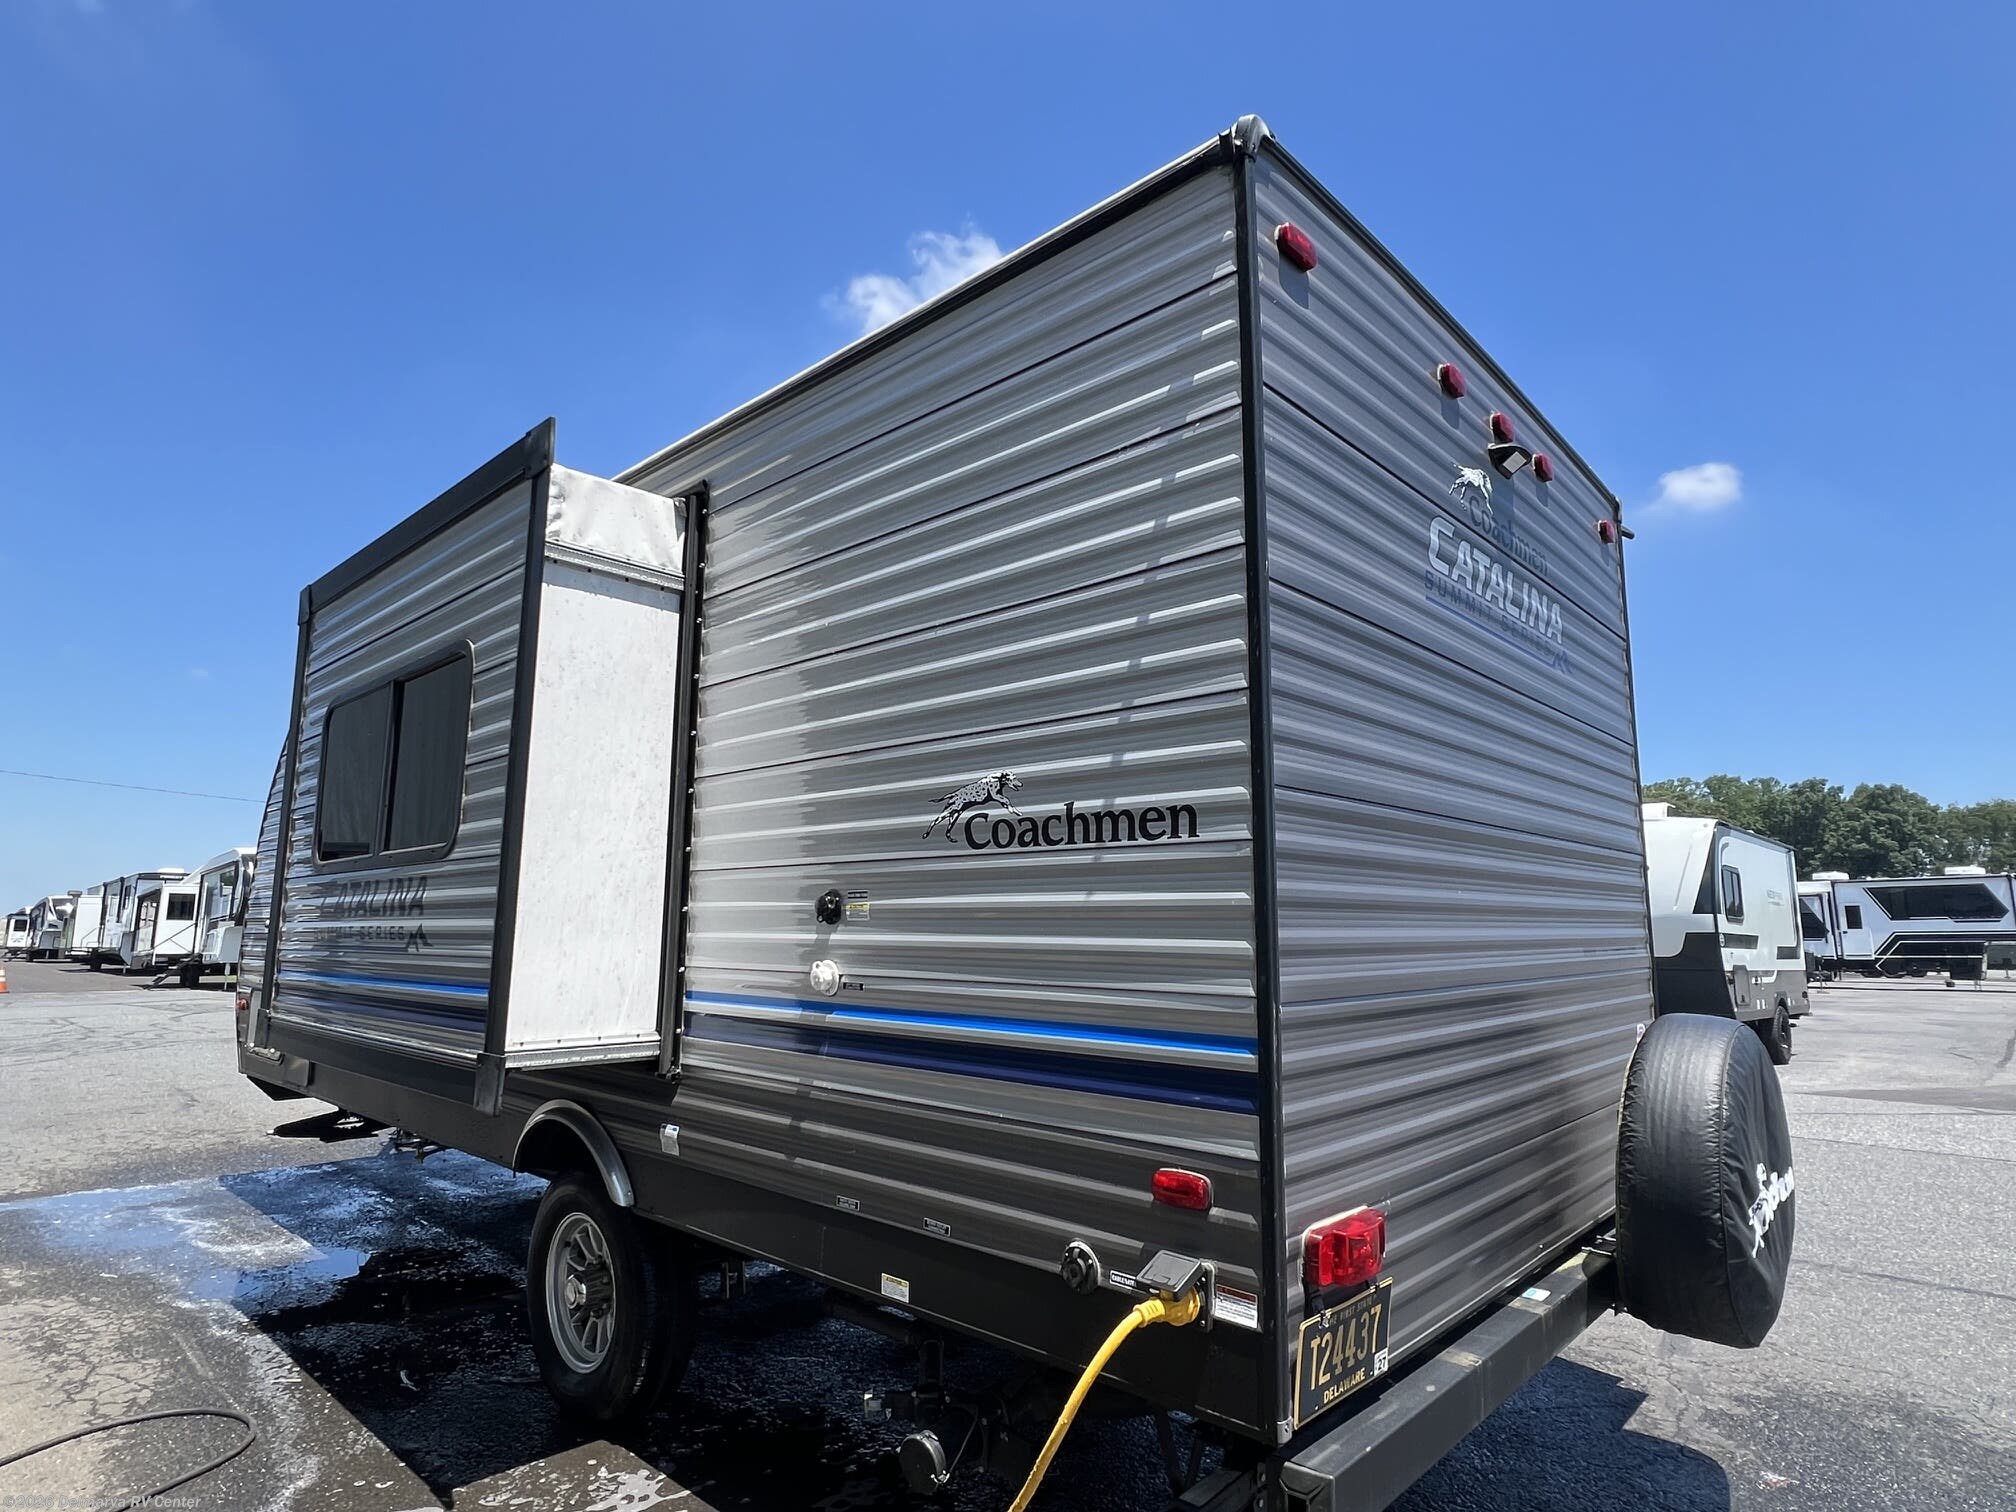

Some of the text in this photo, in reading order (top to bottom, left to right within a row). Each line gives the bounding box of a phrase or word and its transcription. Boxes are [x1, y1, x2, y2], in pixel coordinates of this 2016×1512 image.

[1468, 495, 1549, 576] Coachmen
[1427, 515, 1563, 645] CATALINA
[963, 801, 1200, 850] Coachmen
[359, 925, 406, 940] SERIES
[1310, 1303, 1382, 1390] T24437
[1377, 1355, 1387, 1371] 27
[1323, 1367, 1366, 1404] DELAWARE
